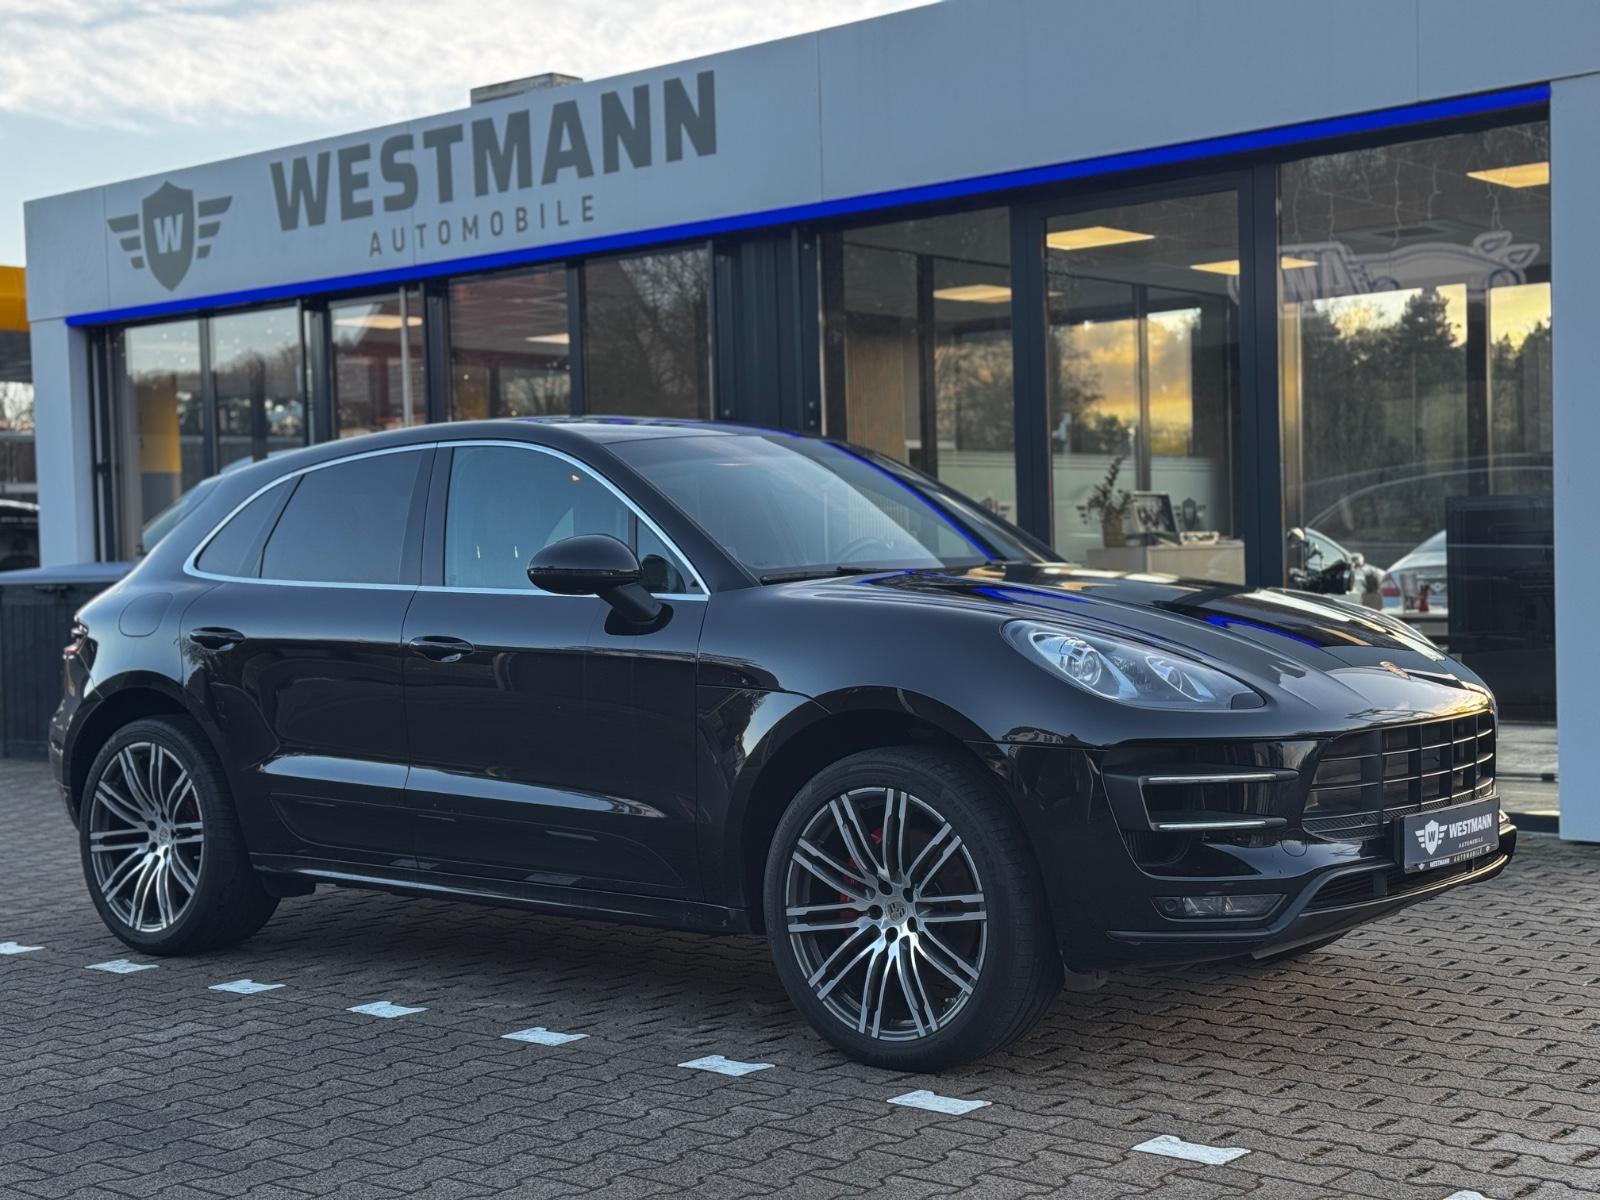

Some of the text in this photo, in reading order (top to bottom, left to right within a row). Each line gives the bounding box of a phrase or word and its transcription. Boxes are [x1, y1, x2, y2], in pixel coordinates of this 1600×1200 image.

[269, 70, 717, 232] WESTMANN
[153, 213, 184, 255] W
[369, 195, 595, 257] AUTOMOBILE
[1428, 830, 1437, 843] W
[1449, 813, 1493, 839] WESTMANN
